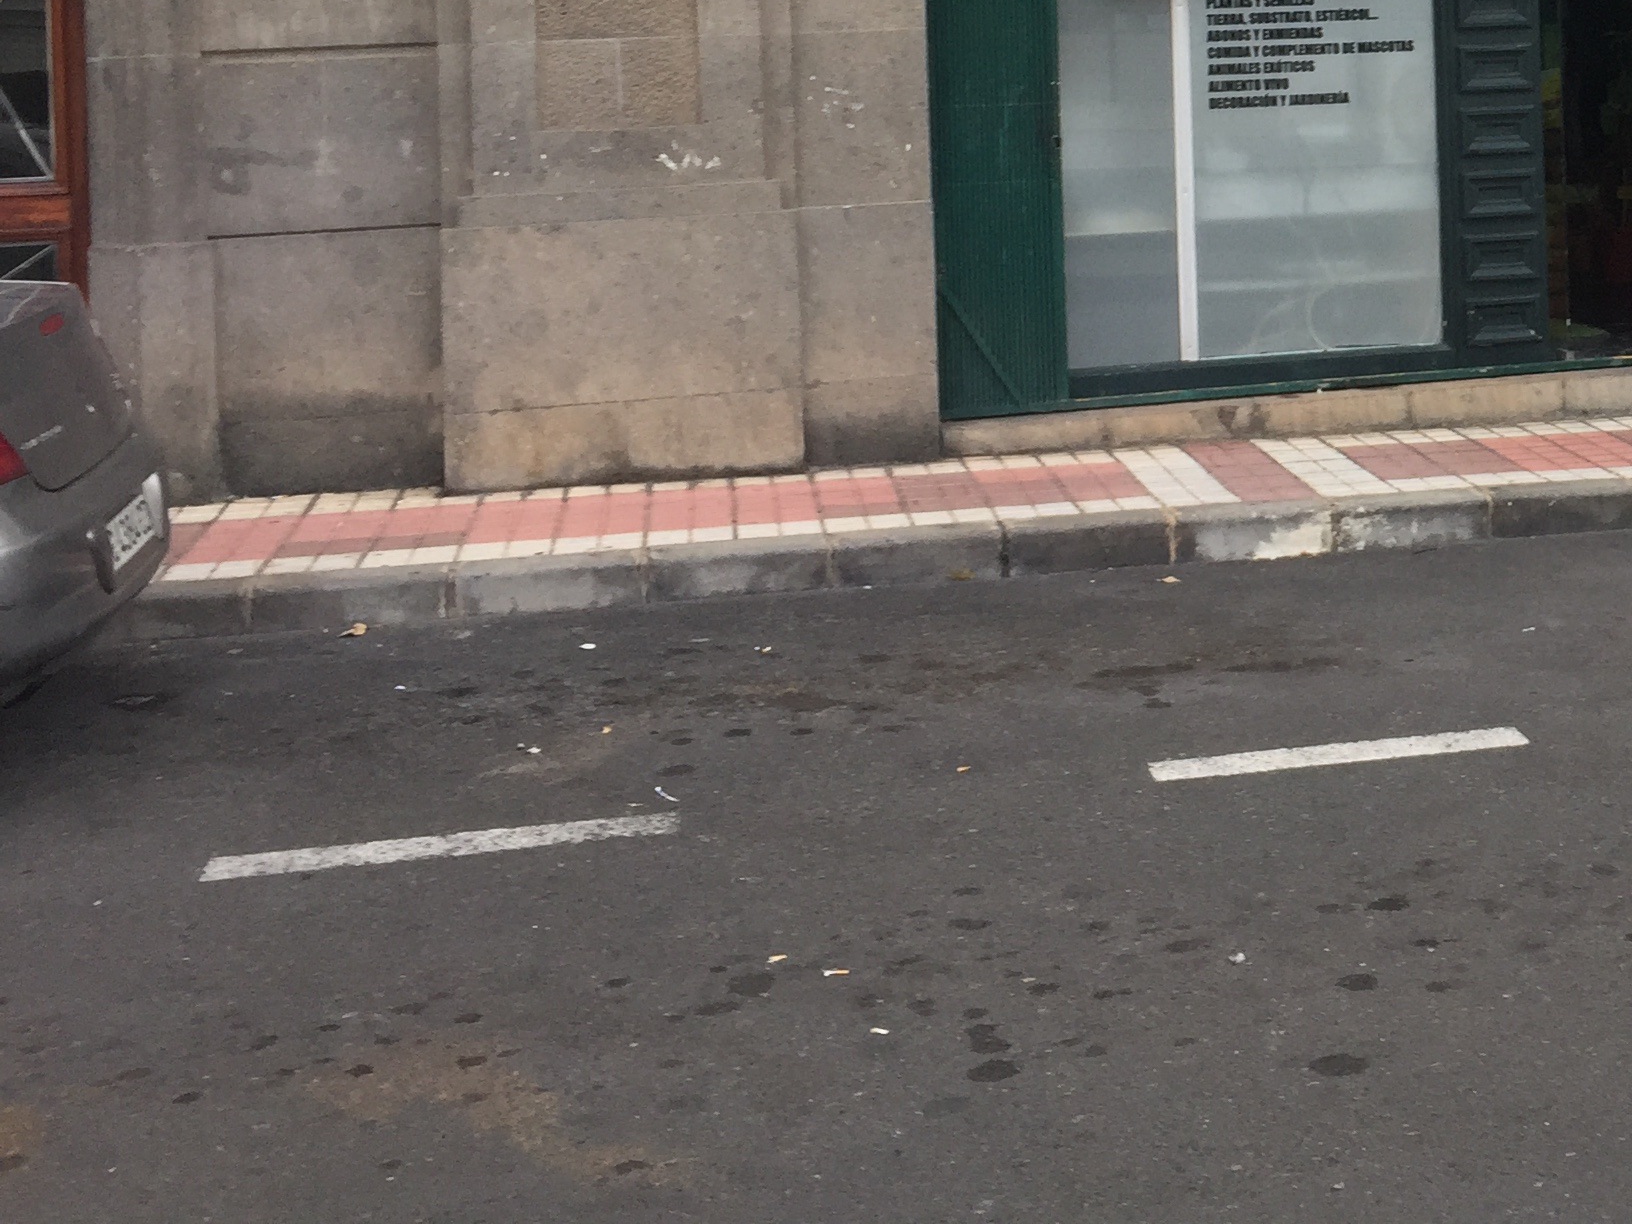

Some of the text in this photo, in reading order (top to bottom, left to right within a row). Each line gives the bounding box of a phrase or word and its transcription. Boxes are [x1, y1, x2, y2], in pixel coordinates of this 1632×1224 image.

[1252, 29, 1260, 40] Y
[1207, 46, 1250, 59] COMIDA
[1252, 46, 1260, 57] Y
[1342, 42, 1355, 54] DE
[1357, 40, 1414, 53] MASCOTAS
[1208, 62, 1261, 75] ANIMALES
[1208, 79, 1261, 92] ALIMENTO
[1280, 95, 1287, 106] Y
